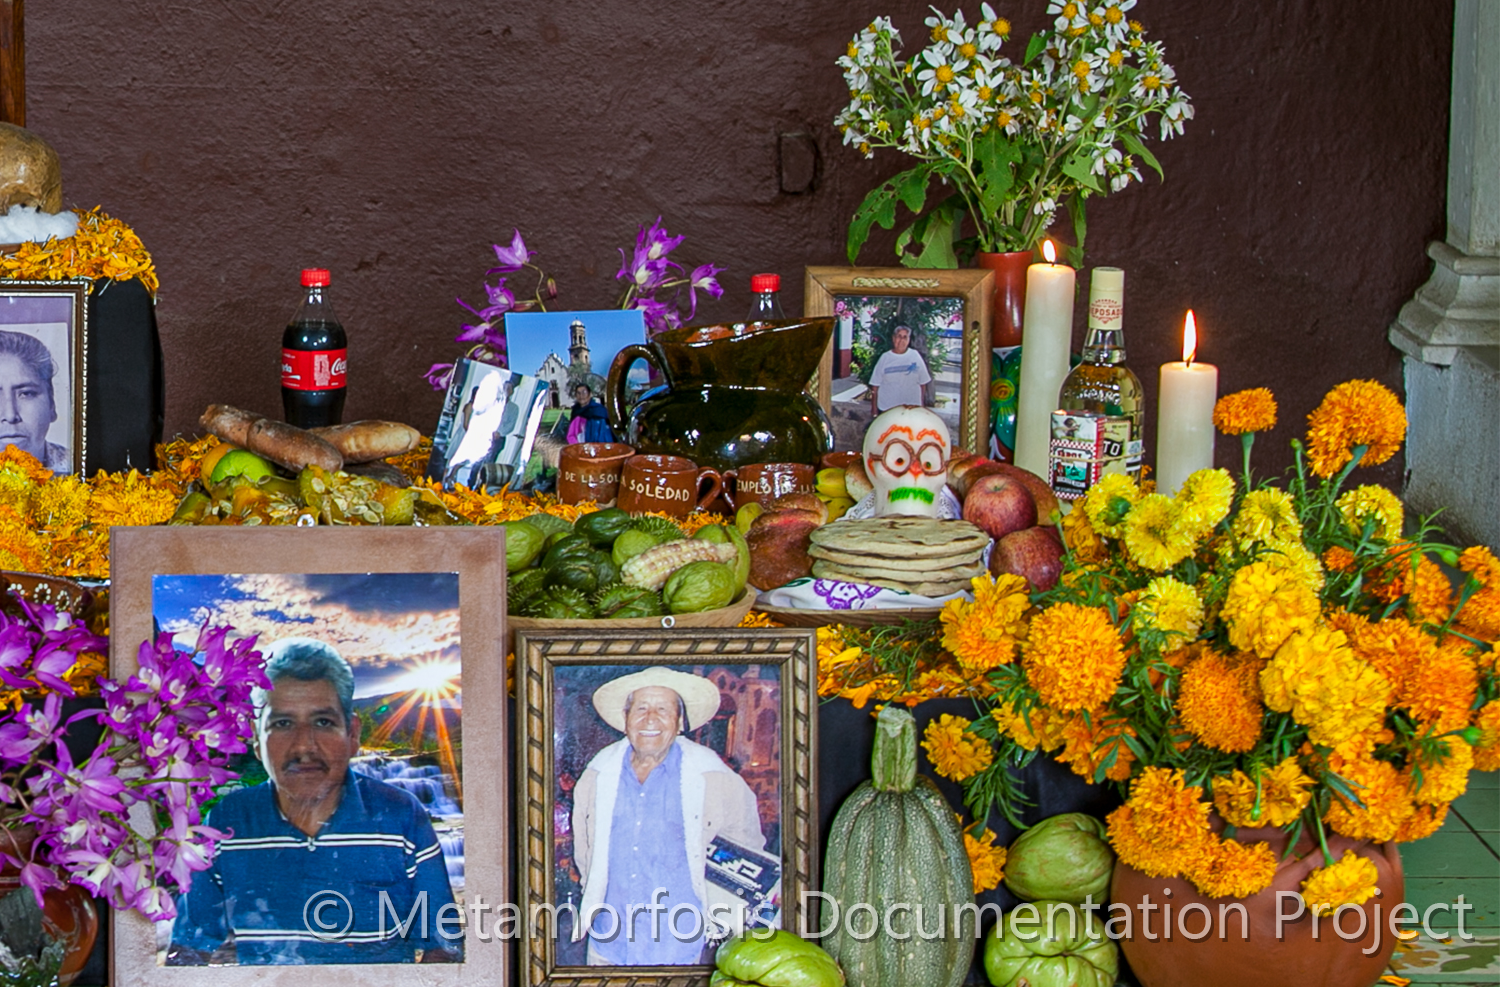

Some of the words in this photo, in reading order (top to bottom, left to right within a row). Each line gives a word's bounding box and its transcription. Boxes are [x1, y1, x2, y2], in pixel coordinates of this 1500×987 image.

[1103, 441, 1120, 456] TO
[565, 471, 577, 482] DE
[599, 473, 619, 485] SOL
[629, 479, 690, 501] SOLEDAD
[736, 480, 772, 495] EMPLO
